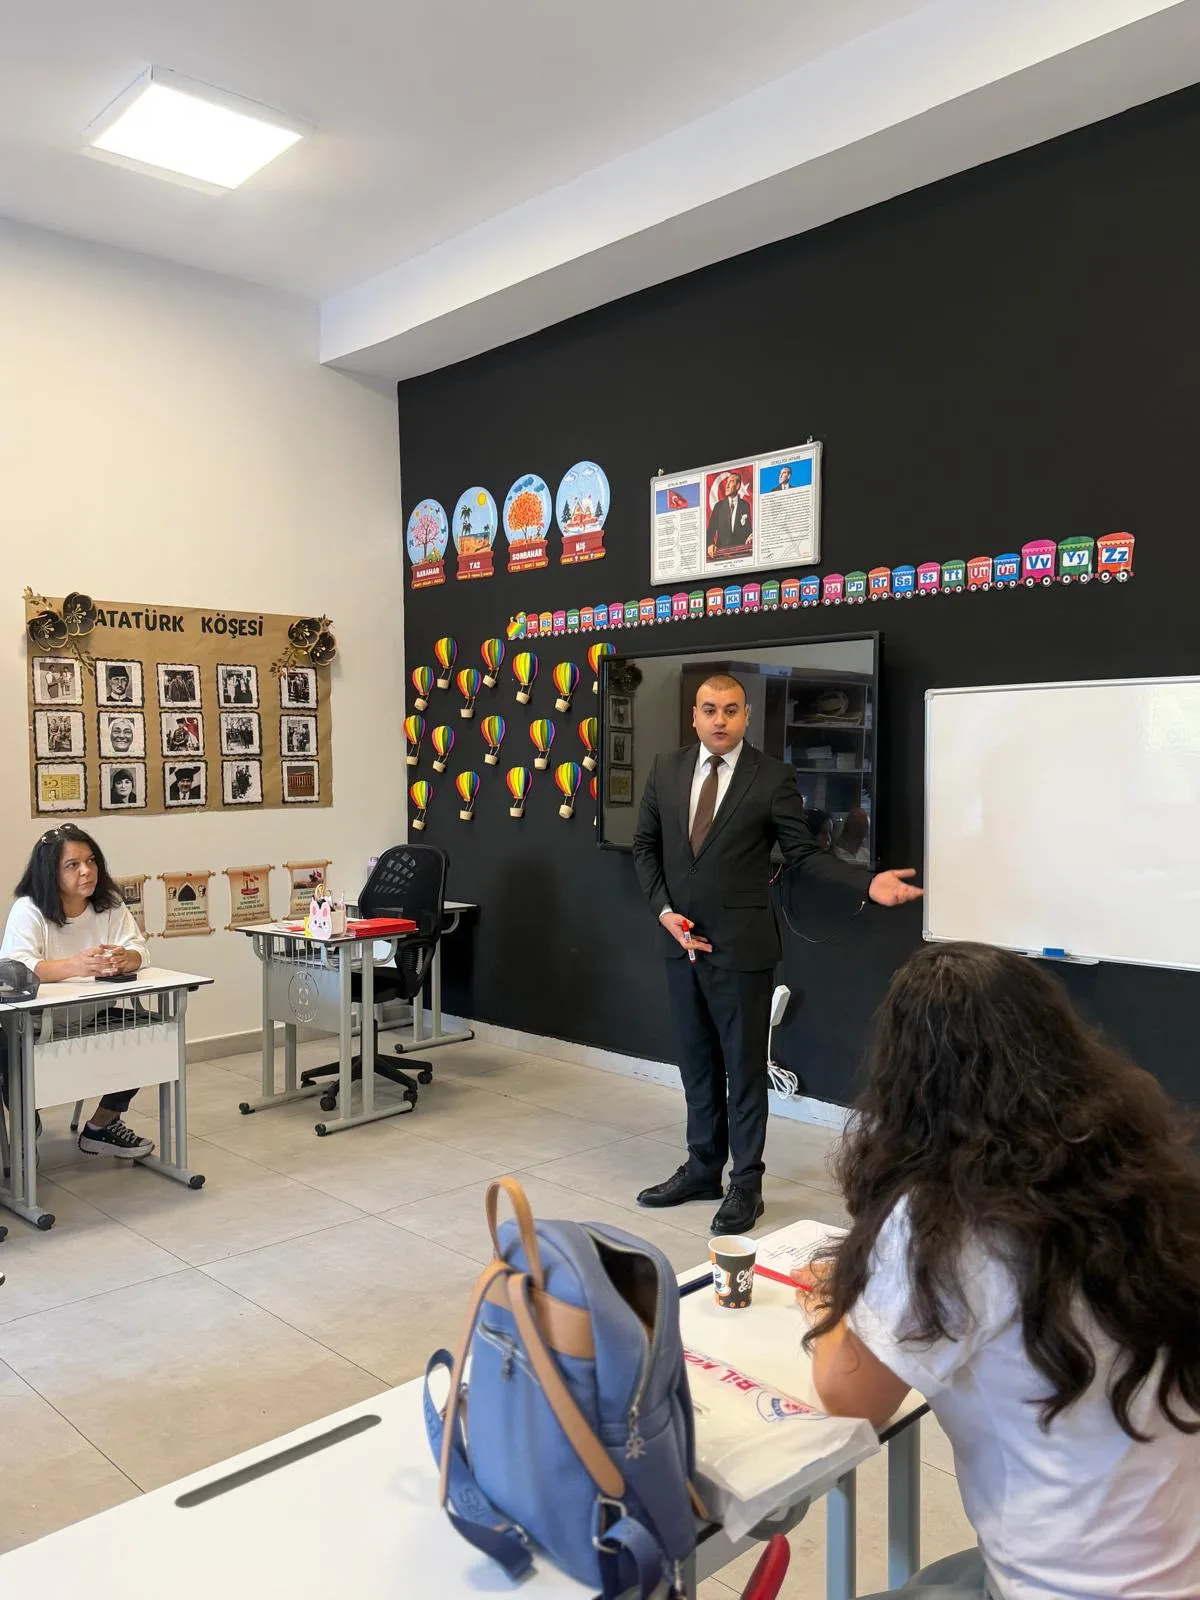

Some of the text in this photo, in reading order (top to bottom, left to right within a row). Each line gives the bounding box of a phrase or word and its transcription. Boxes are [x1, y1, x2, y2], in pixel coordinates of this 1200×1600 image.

[469, 561, 481, 570] YAZ
[849, 581, 863, 592] Pp
[872, 578, 887, 588] Rr
[896, 576, 911, 586] Ss
[946, 570, 961, 581] Tt
[1028, 555, 1051, 569] Vv
[1067, 551, 1085, 565] Yy
[1104, 548, 1129, 563] Zz
[95, 608, 264, 639] ATATÜRK KÖŞESİ
